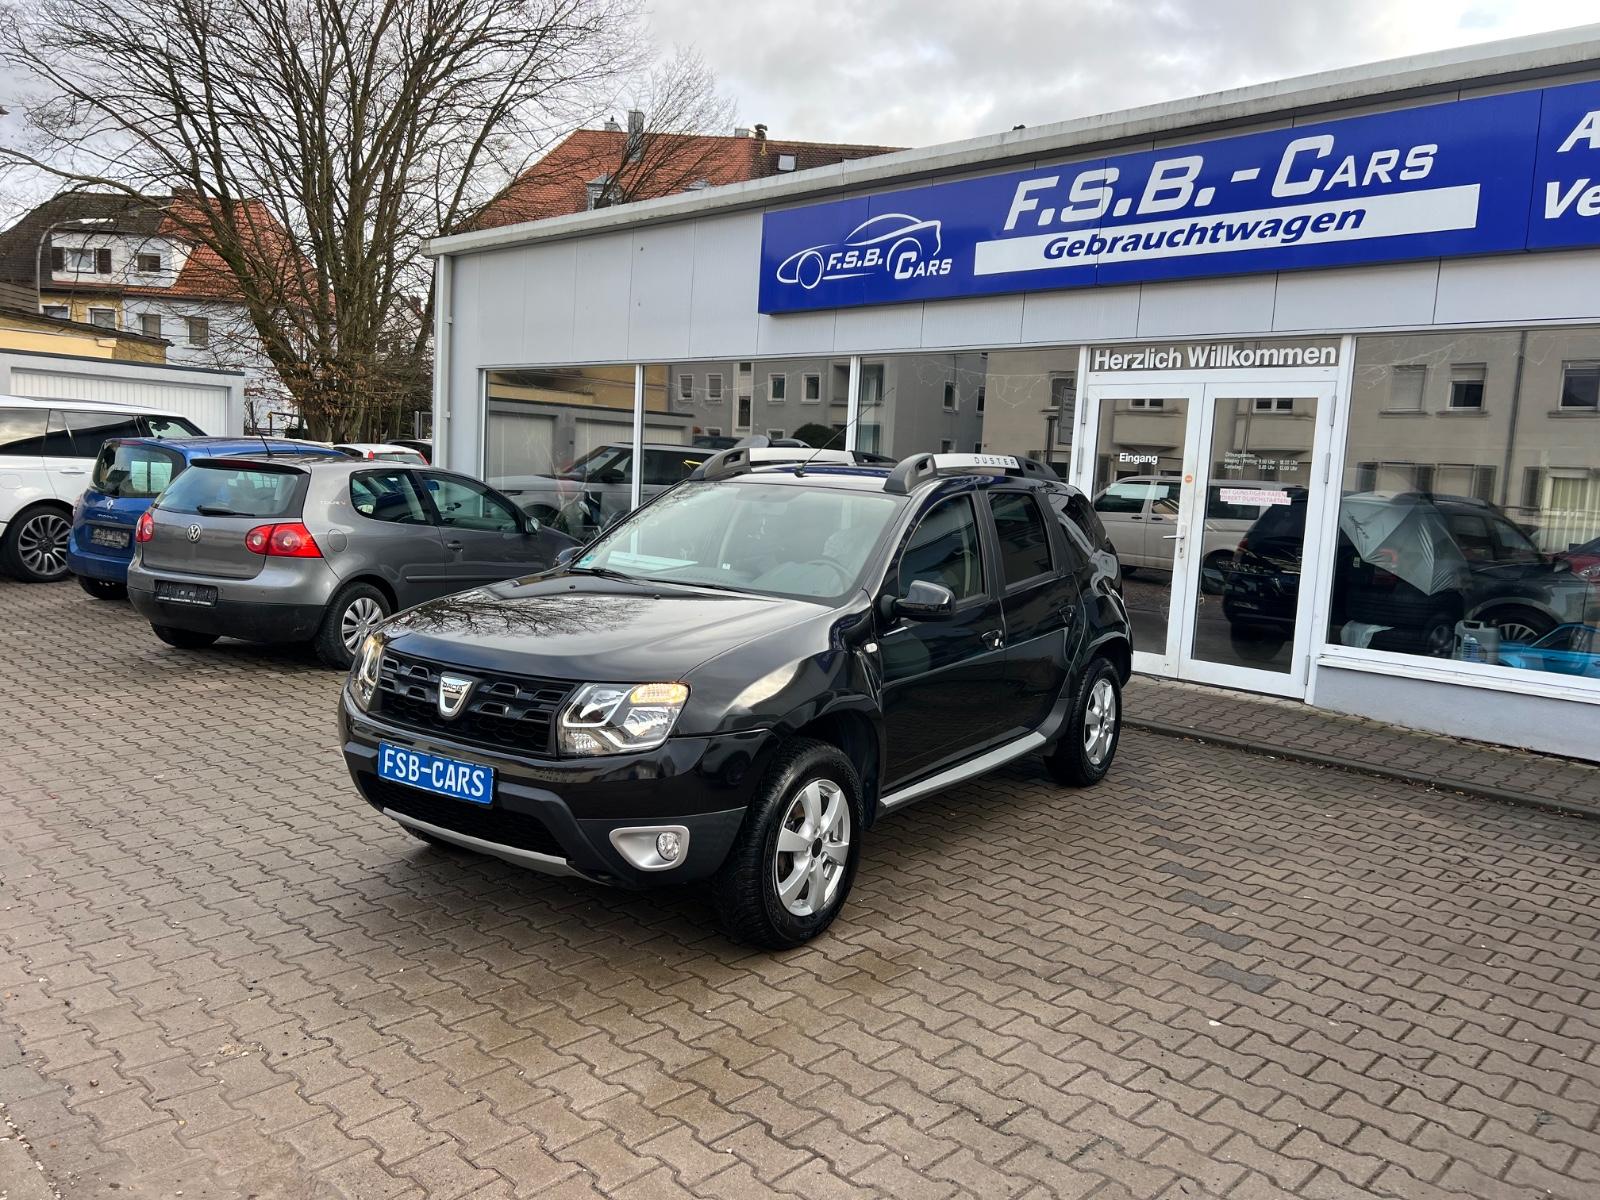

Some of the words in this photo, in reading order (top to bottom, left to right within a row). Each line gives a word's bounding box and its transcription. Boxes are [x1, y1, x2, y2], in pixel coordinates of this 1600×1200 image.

[1043, 207, 1366, 261] Gebrauchtwagen
[826, 248, 883, 271] F.S.B.
[1094, 347, 1182, 370] Herzlich
[1187, 344, 1336, 367] Willkommen
[974, 456, 1016, 467] DUSTER
[1119, 452, 1158, 465] Eingang
[383, 748, 485, 797] FSB-CARS
